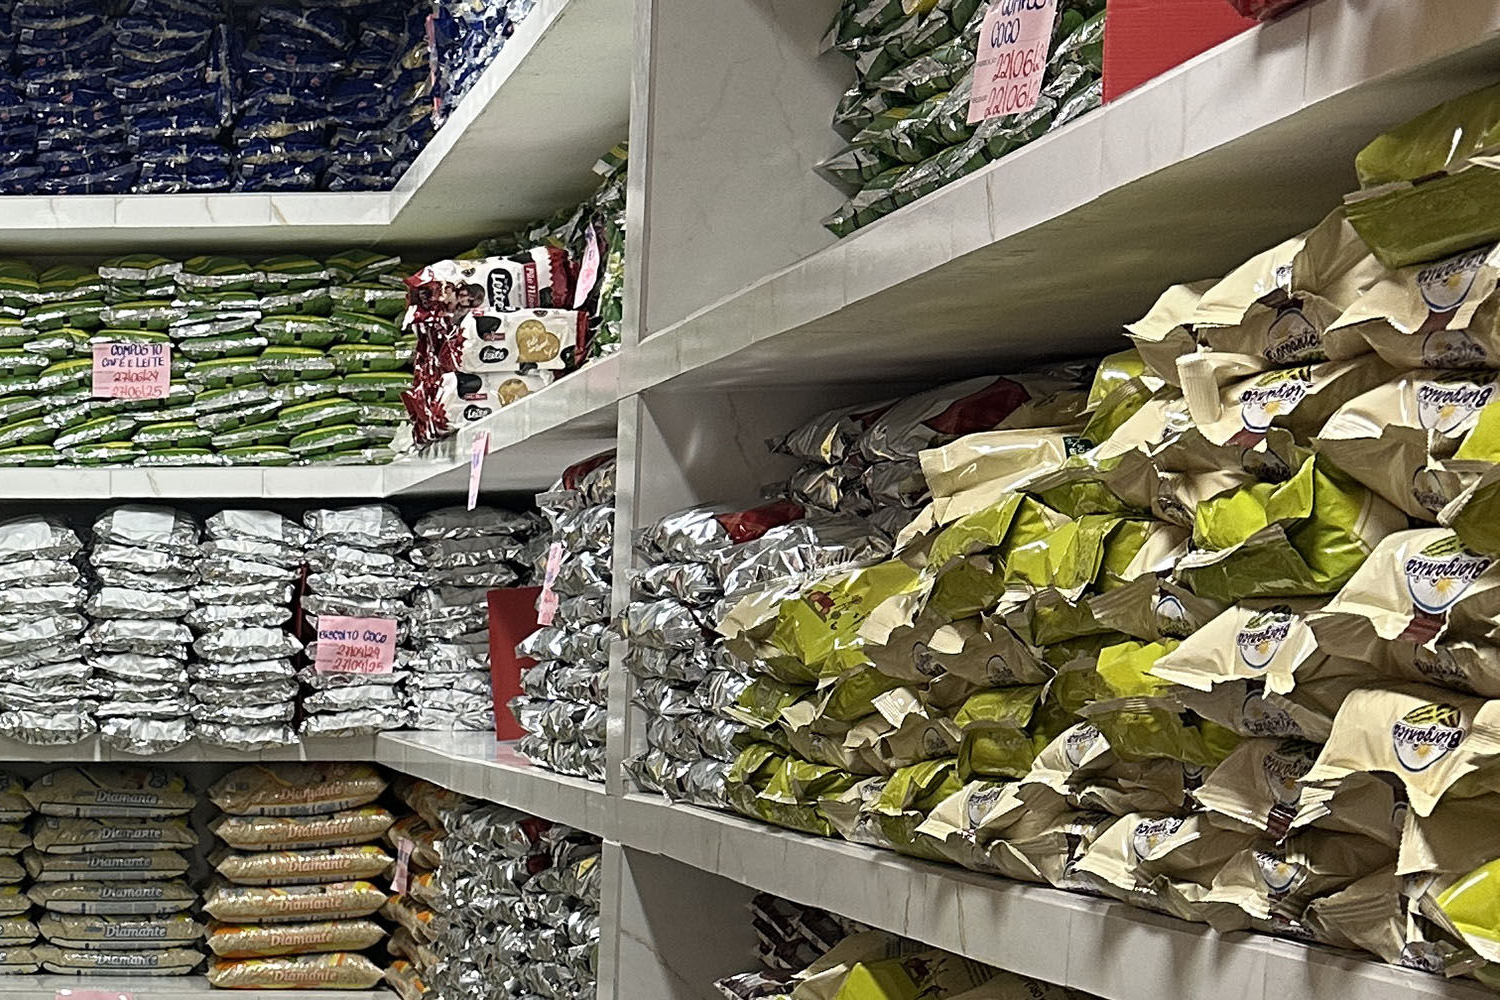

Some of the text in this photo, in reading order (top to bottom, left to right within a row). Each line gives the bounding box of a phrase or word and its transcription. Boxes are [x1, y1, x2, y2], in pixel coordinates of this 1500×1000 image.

[136, 356, 164, 368] LEITE
[1404, 554, 1491, 584] Biorgânica
[105, 924, 168, 938] Diamante
[270, 930, 334, 947] Diamante
